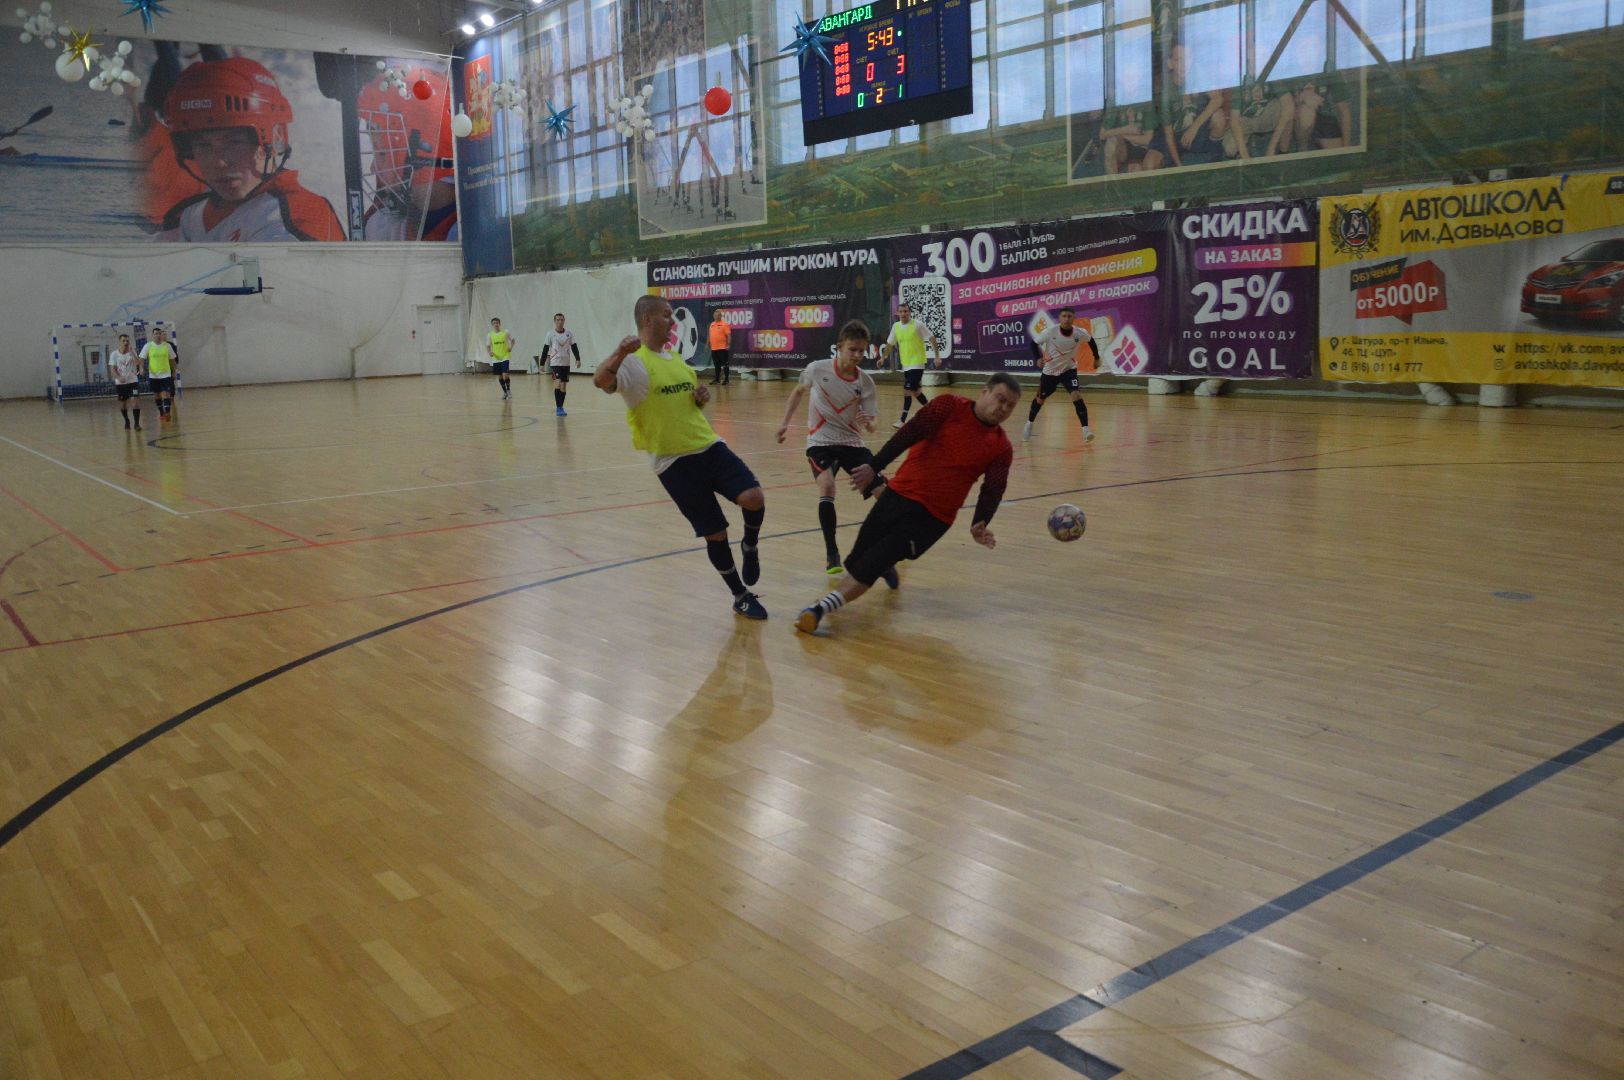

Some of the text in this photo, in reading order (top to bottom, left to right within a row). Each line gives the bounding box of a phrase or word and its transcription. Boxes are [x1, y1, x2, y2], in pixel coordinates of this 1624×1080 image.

[818, 5, 873, 34] АВАНГАРД
[867, 26, 893, 51] 5:43
[866, 62, 875, 82] 0
[896, 54, 905, 75] 3
[857, 92, 865, 107] 0
[876, 87, 883, 104] 2
[898, 83, 903, 98] 1
[1399, 187, 1565, 222] АВТОШКОЛА
[1182, 208, 1308, 240] СКИДКА
[1003, 240, 1022, 250] БАЛЛ
[1031, 233, 1056, 244] РУБЛЬ
[1118, 234, 1137, 244] друга
[921, 232, 995, 278] 300
[1001, 247, 1048, 265] БАЛЛОВ
[1205, 247, 1282, 264] НА ЗАКАЗ
[653, 248, 879, 281] СТАНОВИСЬ ЛУЧШИМ ИГРОКОМ ТУРА
[1351, 264, 1399, 283] ОБУЧЕНИЕ
[958, 256, 1143, 299] за скачивание приложения
[661, 283, 732, 299] И ПОЛУЧАЙ ПРИЗ
[1001, 303, 1009, 313] и
[1011, 298, 1038, 315] ролл
[1089, 291, 1095, 299] в
[1097, 281, 1151, 300] подарок
[1191, 272, 1291, 324] 25%
[1357, 298, 1374, 310] от
[982, 321, 1023, 336] ПРОМО
[1183, 331, 1296, 340] ПО ПРОМОКОДУ
[1003, 335, 1025, 346] 1111
[1189, 347, 1286, 370] GOAL
[1404, 362, 1424, 372] 777
